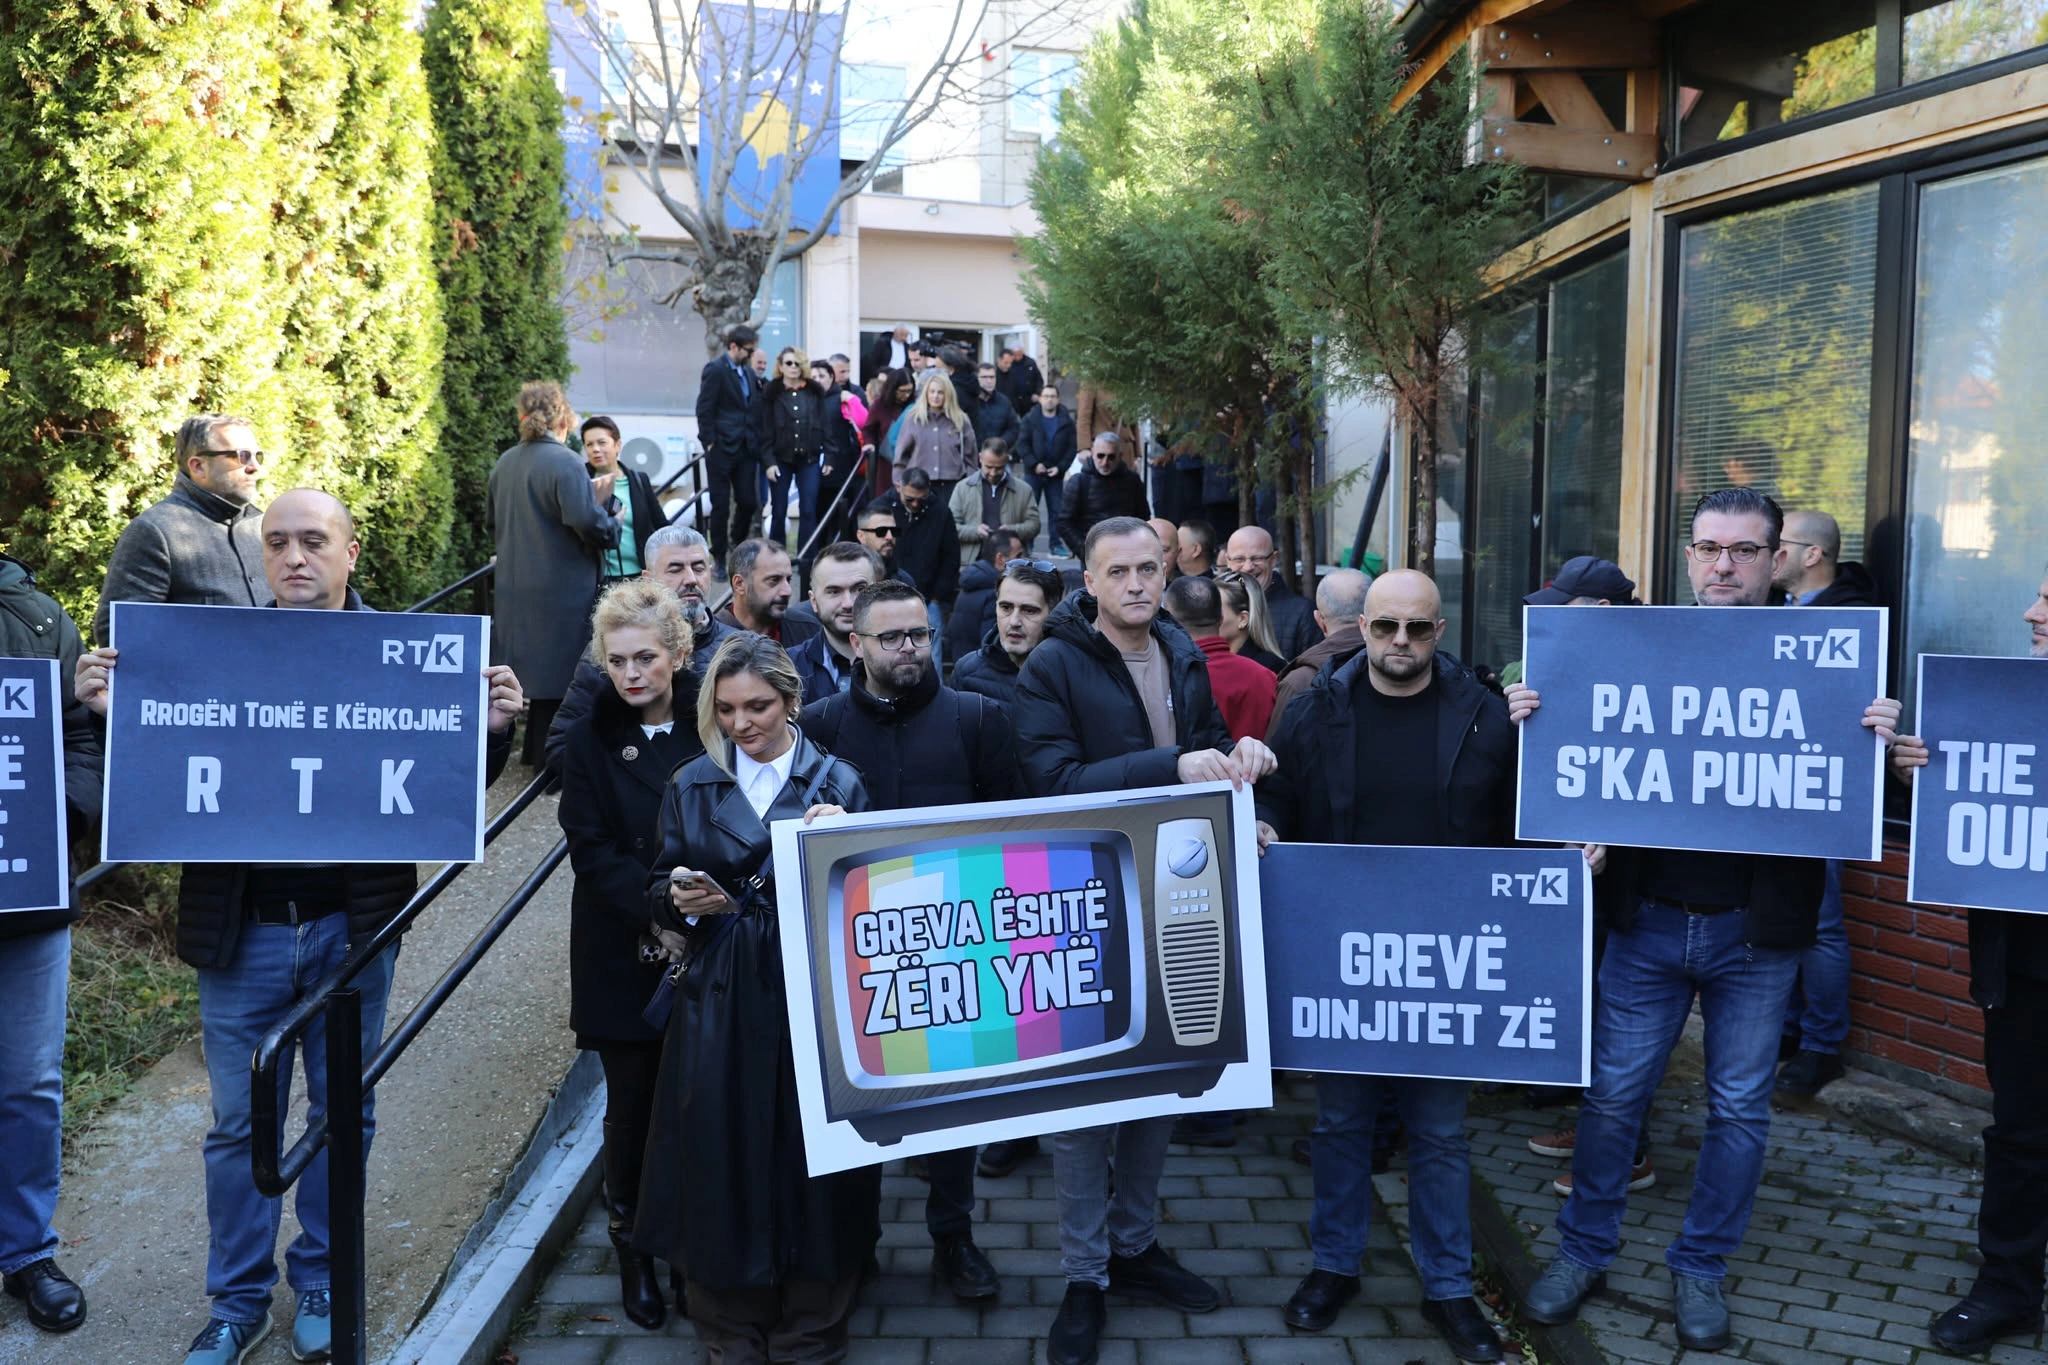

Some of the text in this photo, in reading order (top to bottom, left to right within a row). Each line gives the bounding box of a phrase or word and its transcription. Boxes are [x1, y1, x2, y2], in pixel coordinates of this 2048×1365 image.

[382, 634, 465, 674] RTK
[1774, 629, 1860, 669] RTK
[1592, 683, 1806, 740] PA PAGA
[186, 755, 415, 815] R T K
[1556, 742, 1844, 812] S'KA PUNË!
[1938, 740, 2036, 796] THE
[1491, 867, 1569, 905] RTK
[855, 880, 1108, 958] GREVA ËSHTË
[862, 936, 1113, 1035] ZËRI YNË.
[1340, 923, 1507, 991] GREVË
[1292, 996, 1557, 1050] DINJITET ZË
